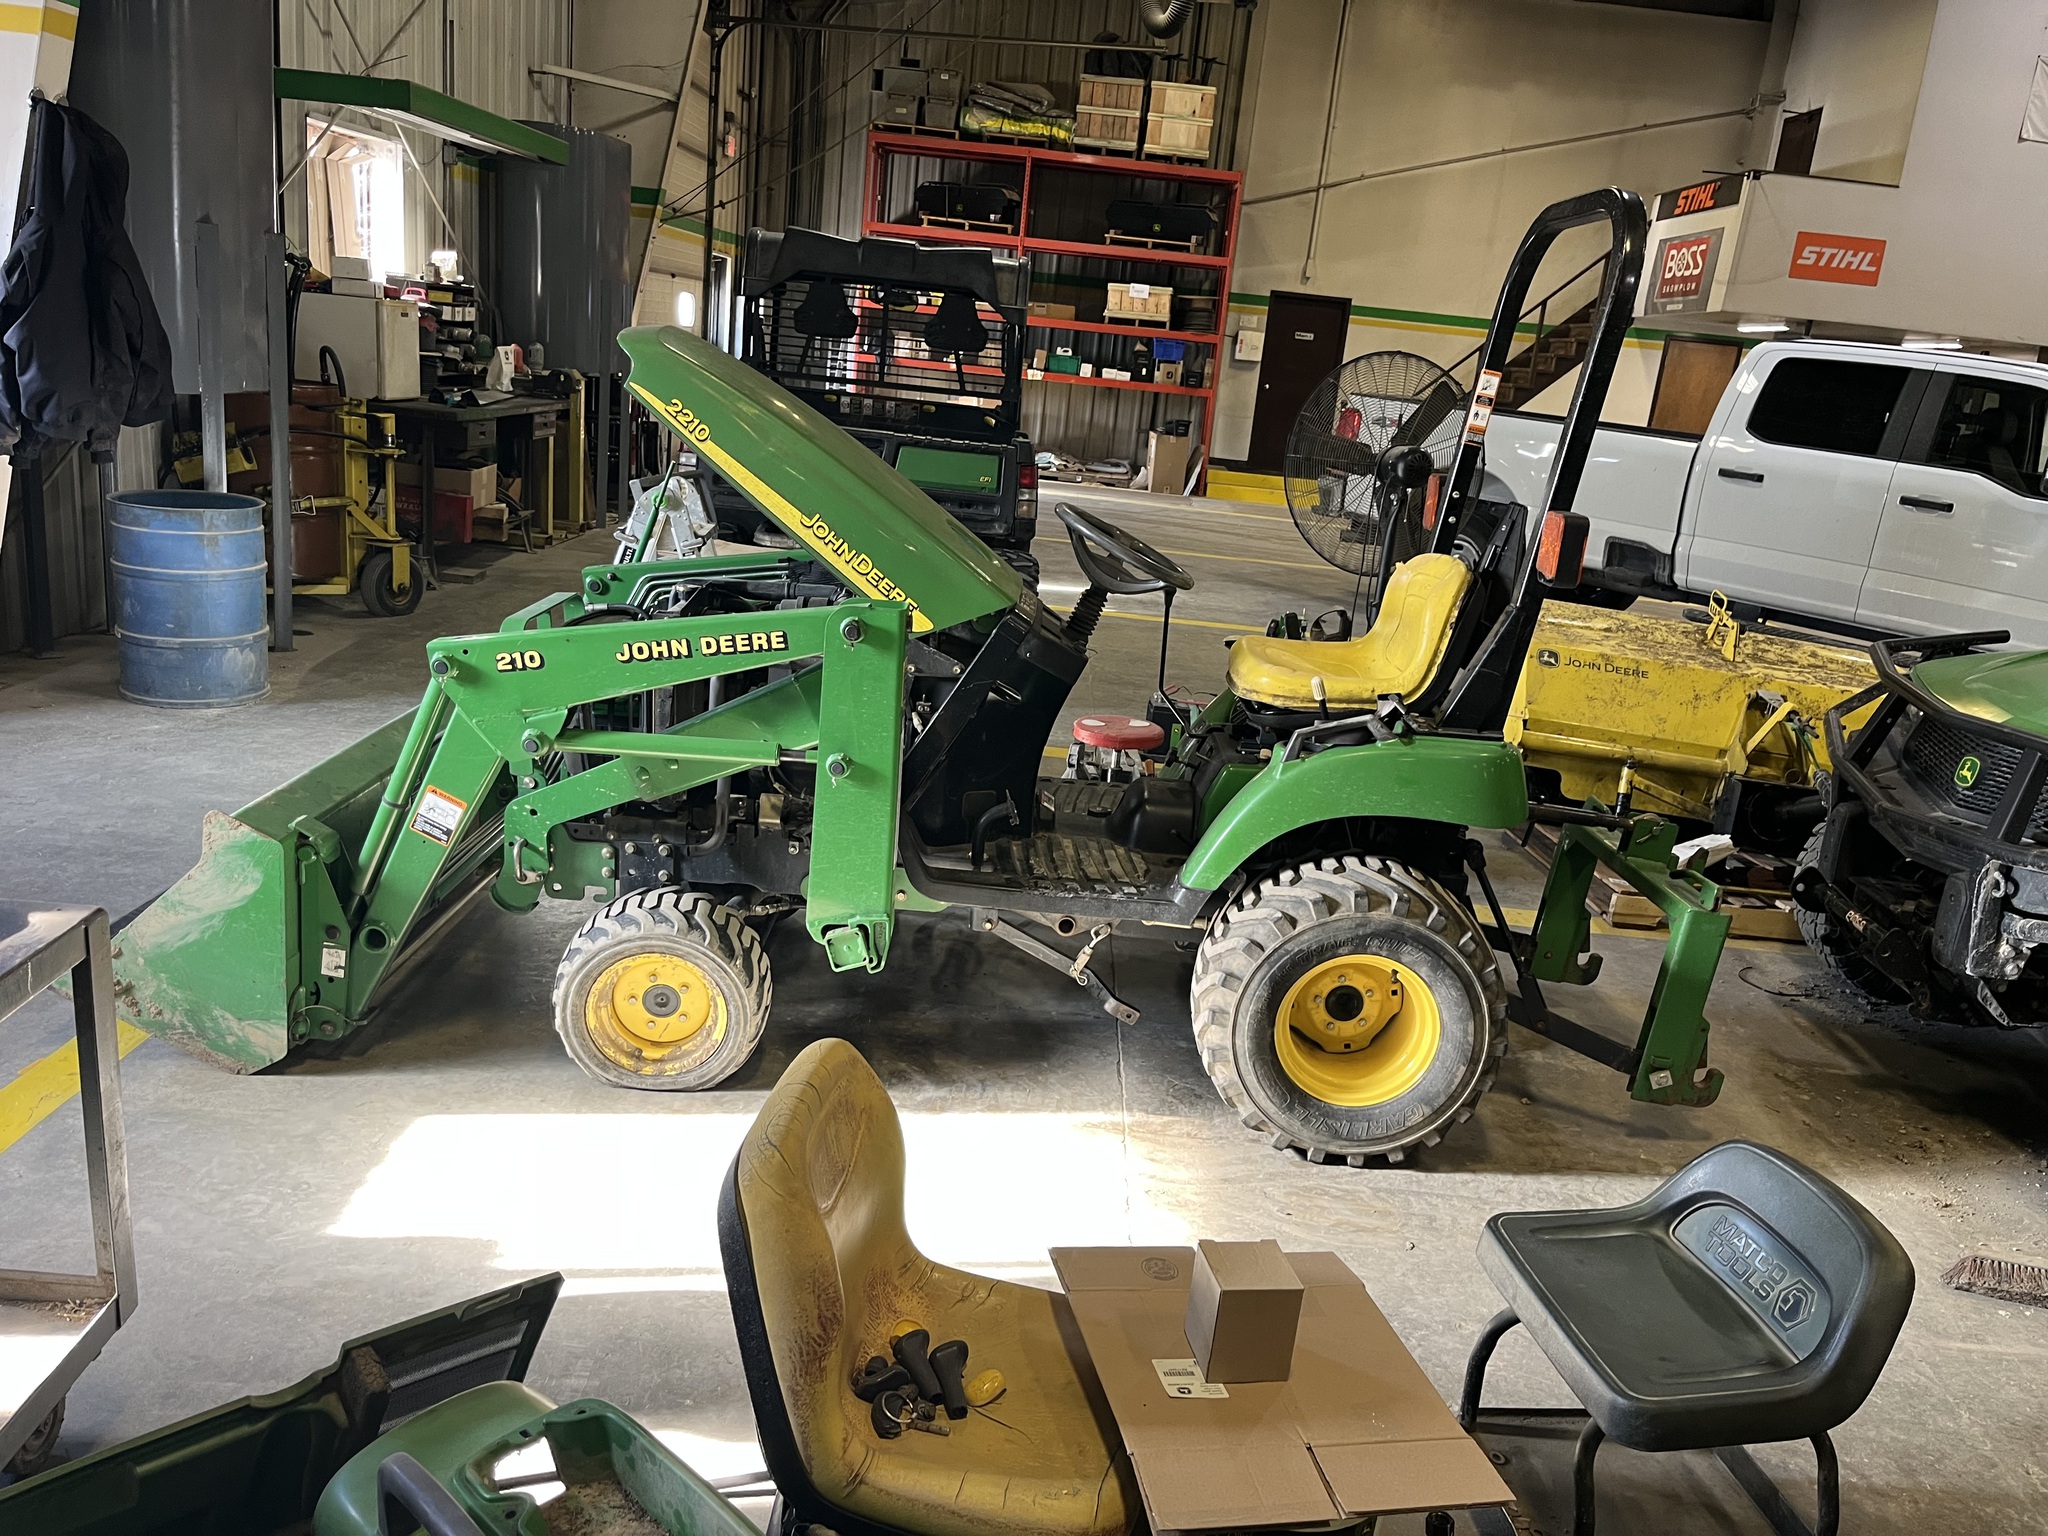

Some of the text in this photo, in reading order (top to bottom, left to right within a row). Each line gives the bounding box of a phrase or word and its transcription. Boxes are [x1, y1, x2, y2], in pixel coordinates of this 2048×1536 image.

[1674, 182, 1716, 215] STIHL
[1664, 244, 1707, 279] BOSS
[1797, 245, 1878, 272] STIHL
[1662, 282, 1696, 293] SNOWPLOW
[665, 398, 711, 441] 2210
[800, 513, 857, 564] JOHN
[496, 650, 545, 672] 210
[615, 630, 789, 663] JOHN DEERE
[1564, 656, 1650, 679] JOHN DEERE
[439, 792, 463, 807] WARNING
[1294, 1102, 1425, 1137] CARLISLE
[1705, 1230, 1775, 1301] TOOLS
[1713, 1214, 1788, 1286] MATCO
